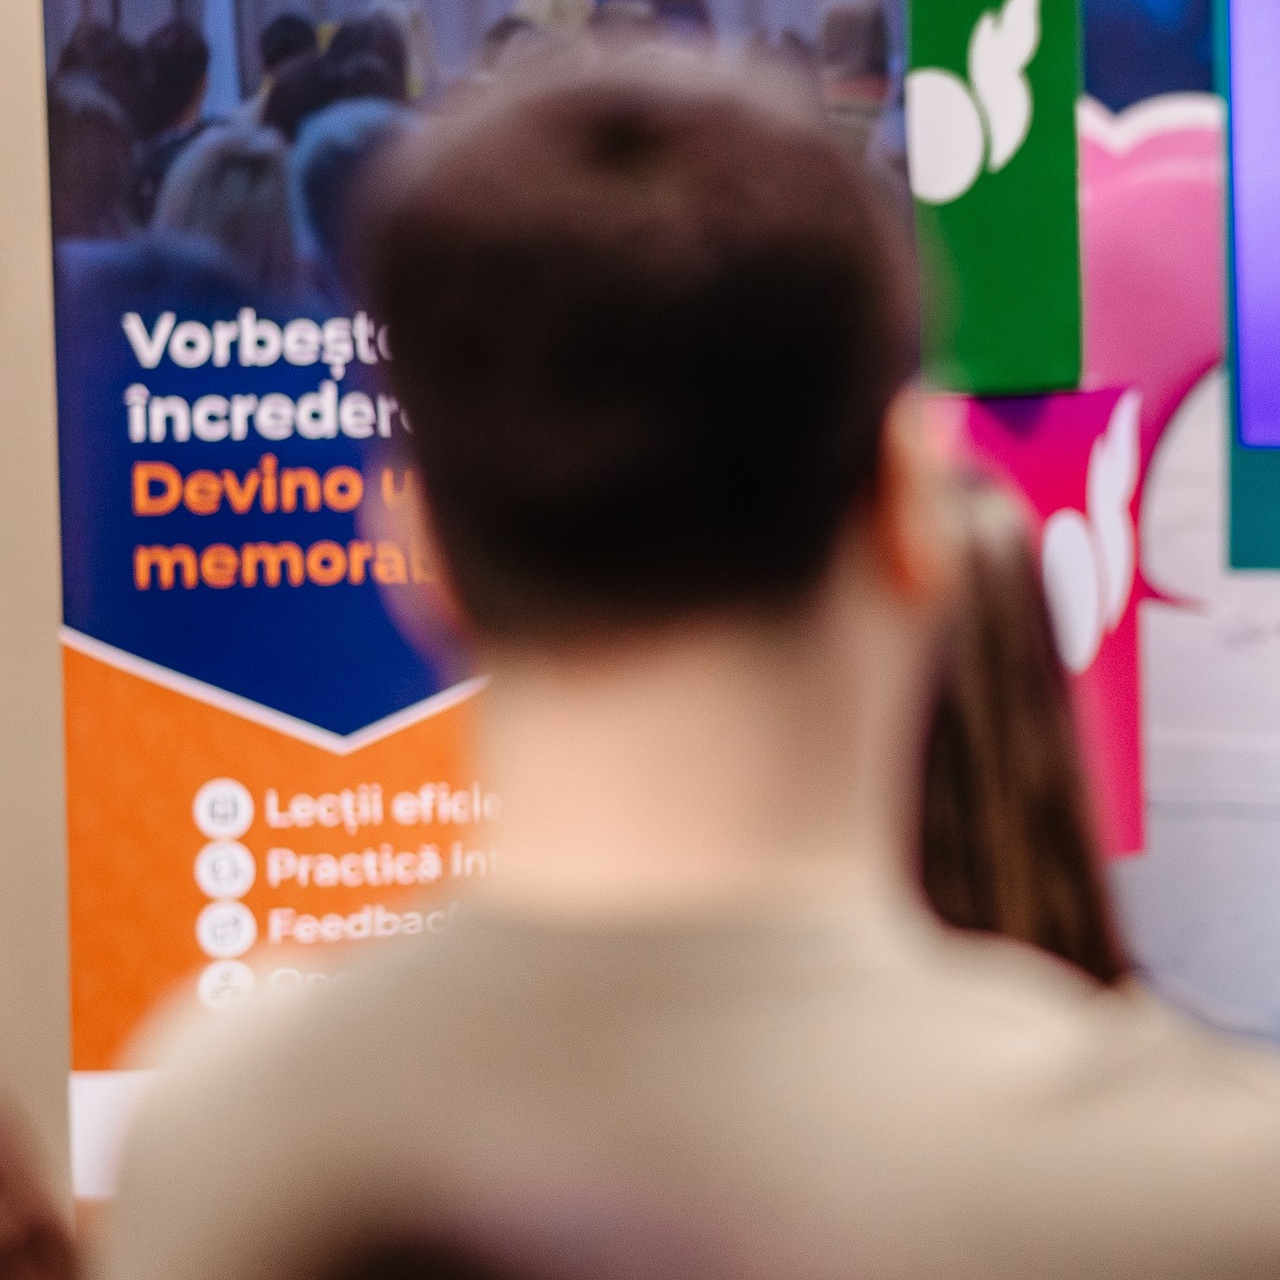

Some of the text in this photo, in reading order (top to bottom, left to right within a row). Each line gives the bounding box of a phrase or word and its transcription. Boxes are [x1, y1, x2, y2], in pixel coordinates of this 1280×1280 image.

[124, 382, 414, 444] încreder
[131, 452, 365, 517] Devino
[267, 902, 459, 945] Feedbac
